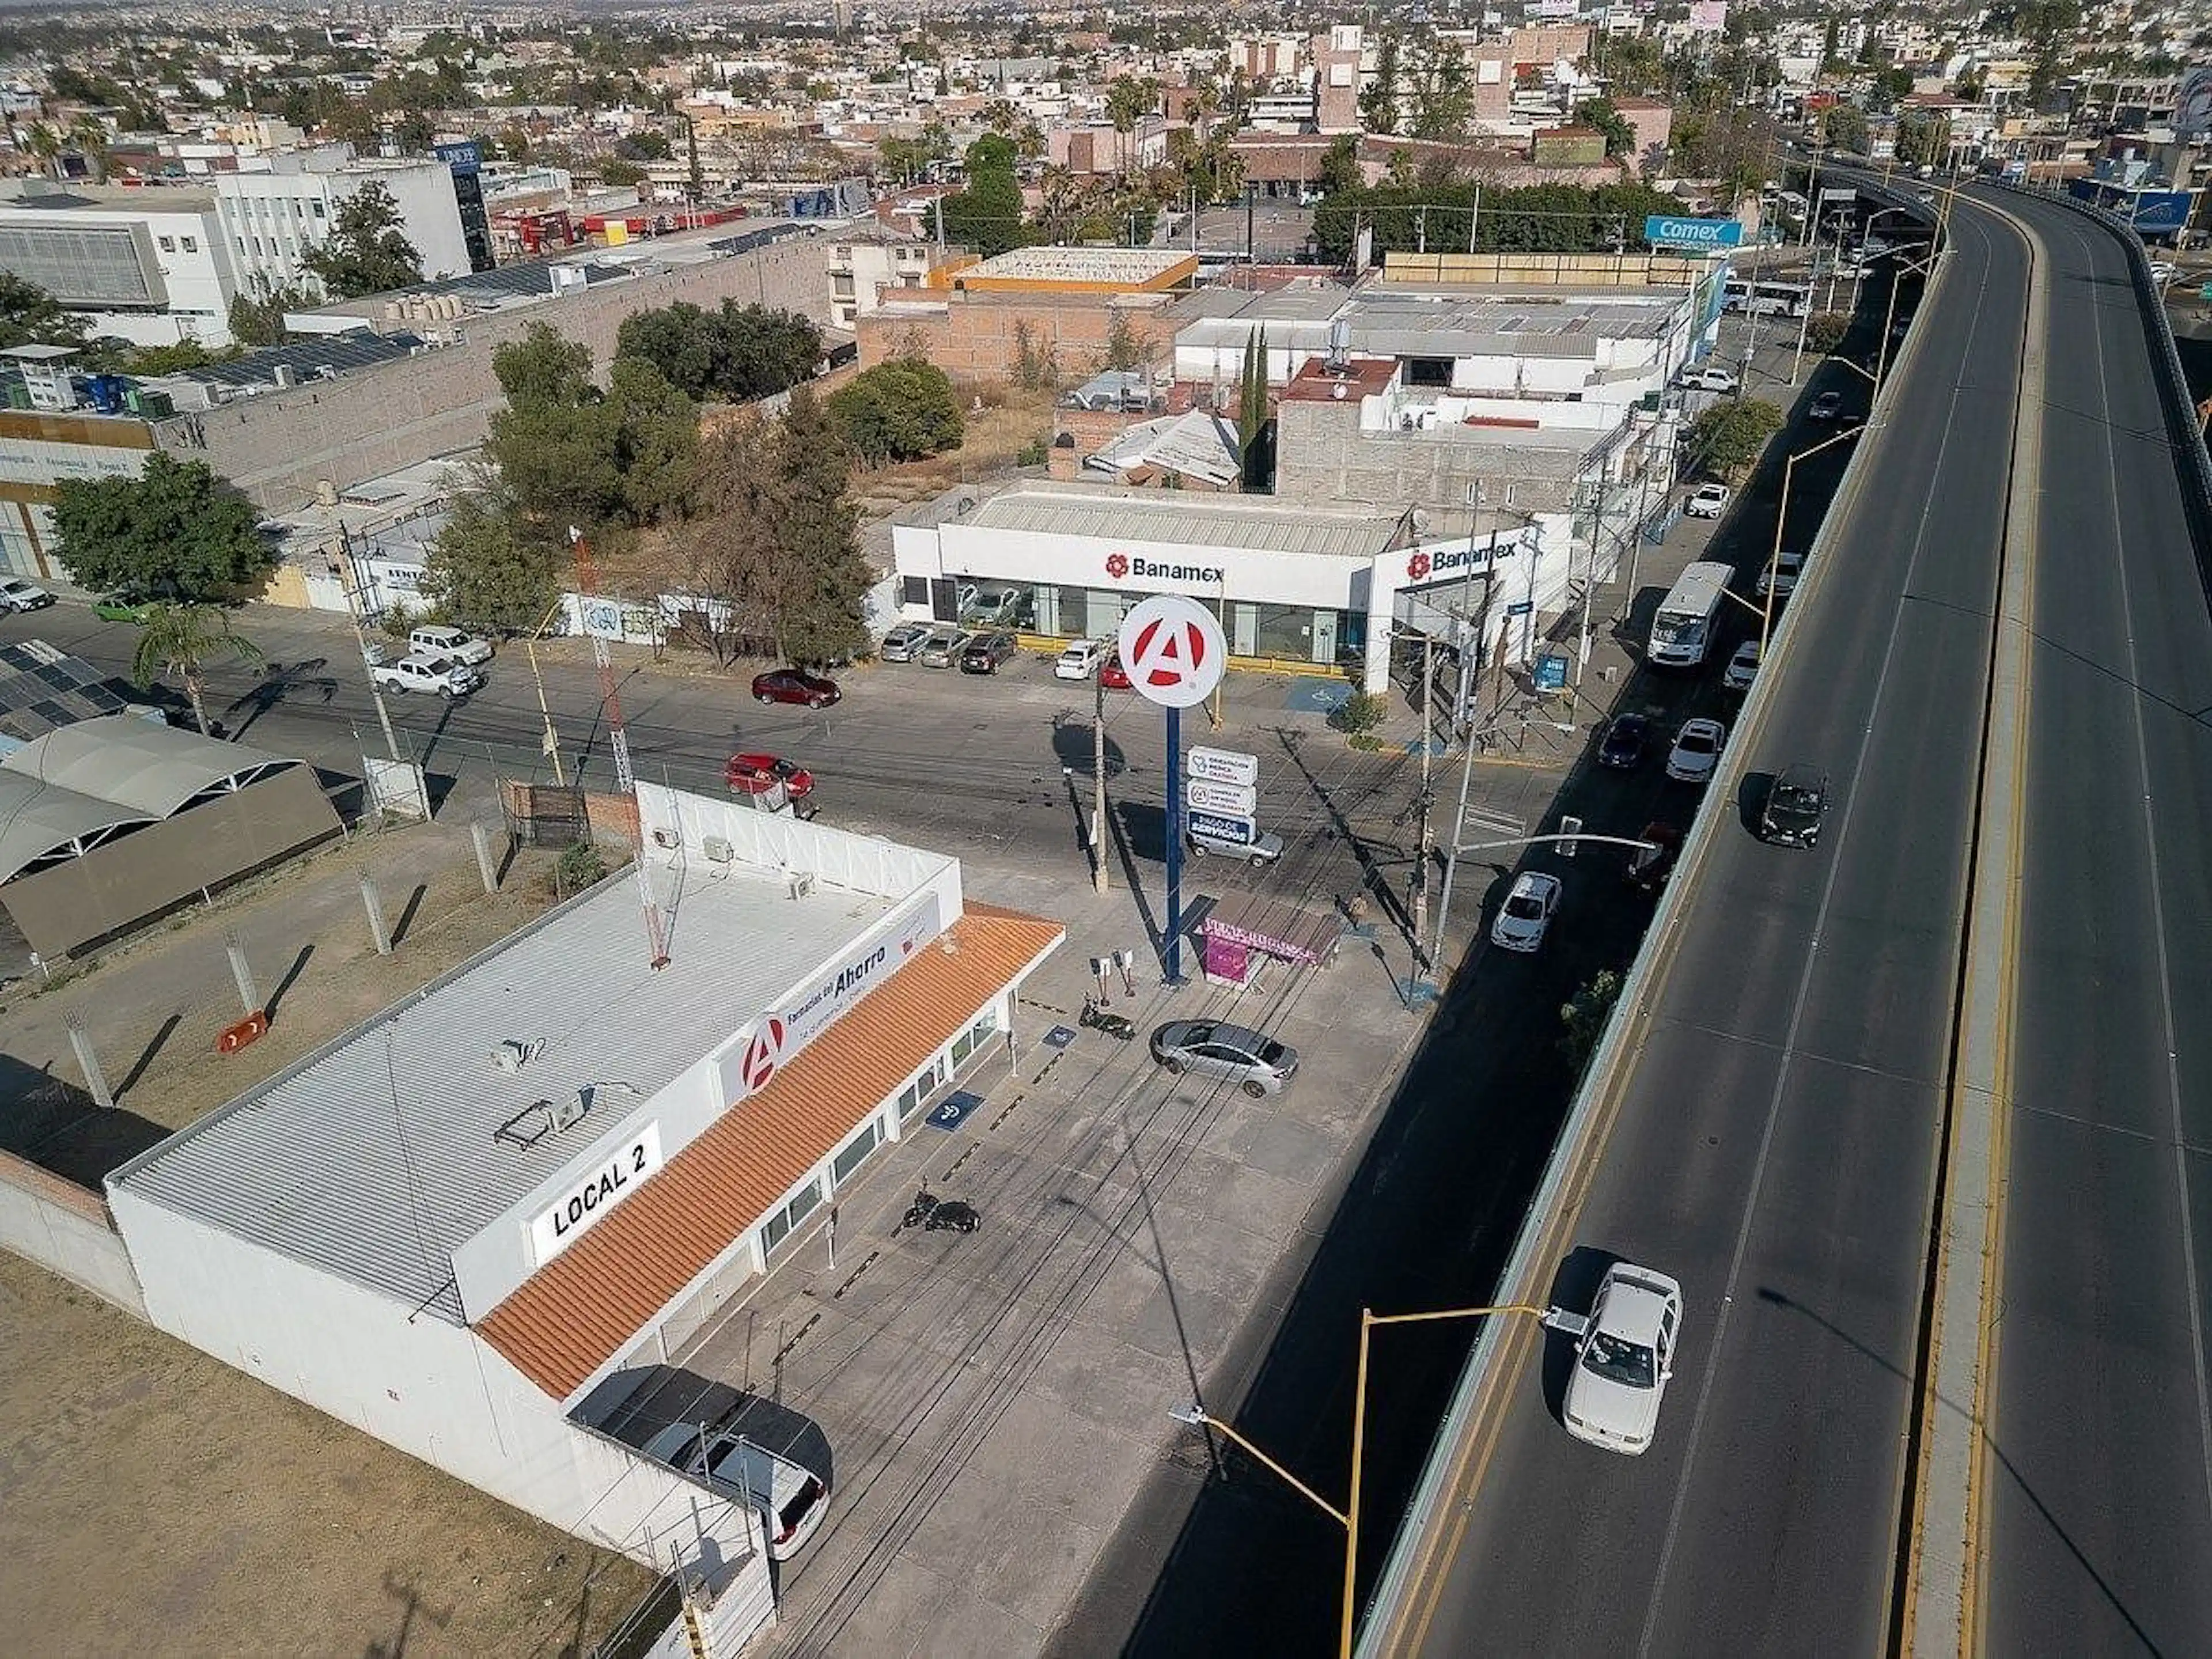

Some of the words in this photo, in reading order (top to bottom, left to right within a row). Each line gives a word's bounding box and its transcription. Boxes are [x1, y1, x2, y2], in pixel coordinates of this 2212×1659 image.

[1660, 221, 1726, 240] Comex
[1132, 558, 1224, 583] Banamex
[1191, 821, 1247, 842] SERVICIOS
[834, 945, 886, 998] Ahorro
[554, 1162, 627, 1237] LOCAL
[632, 1144, 646, 1173] 2
